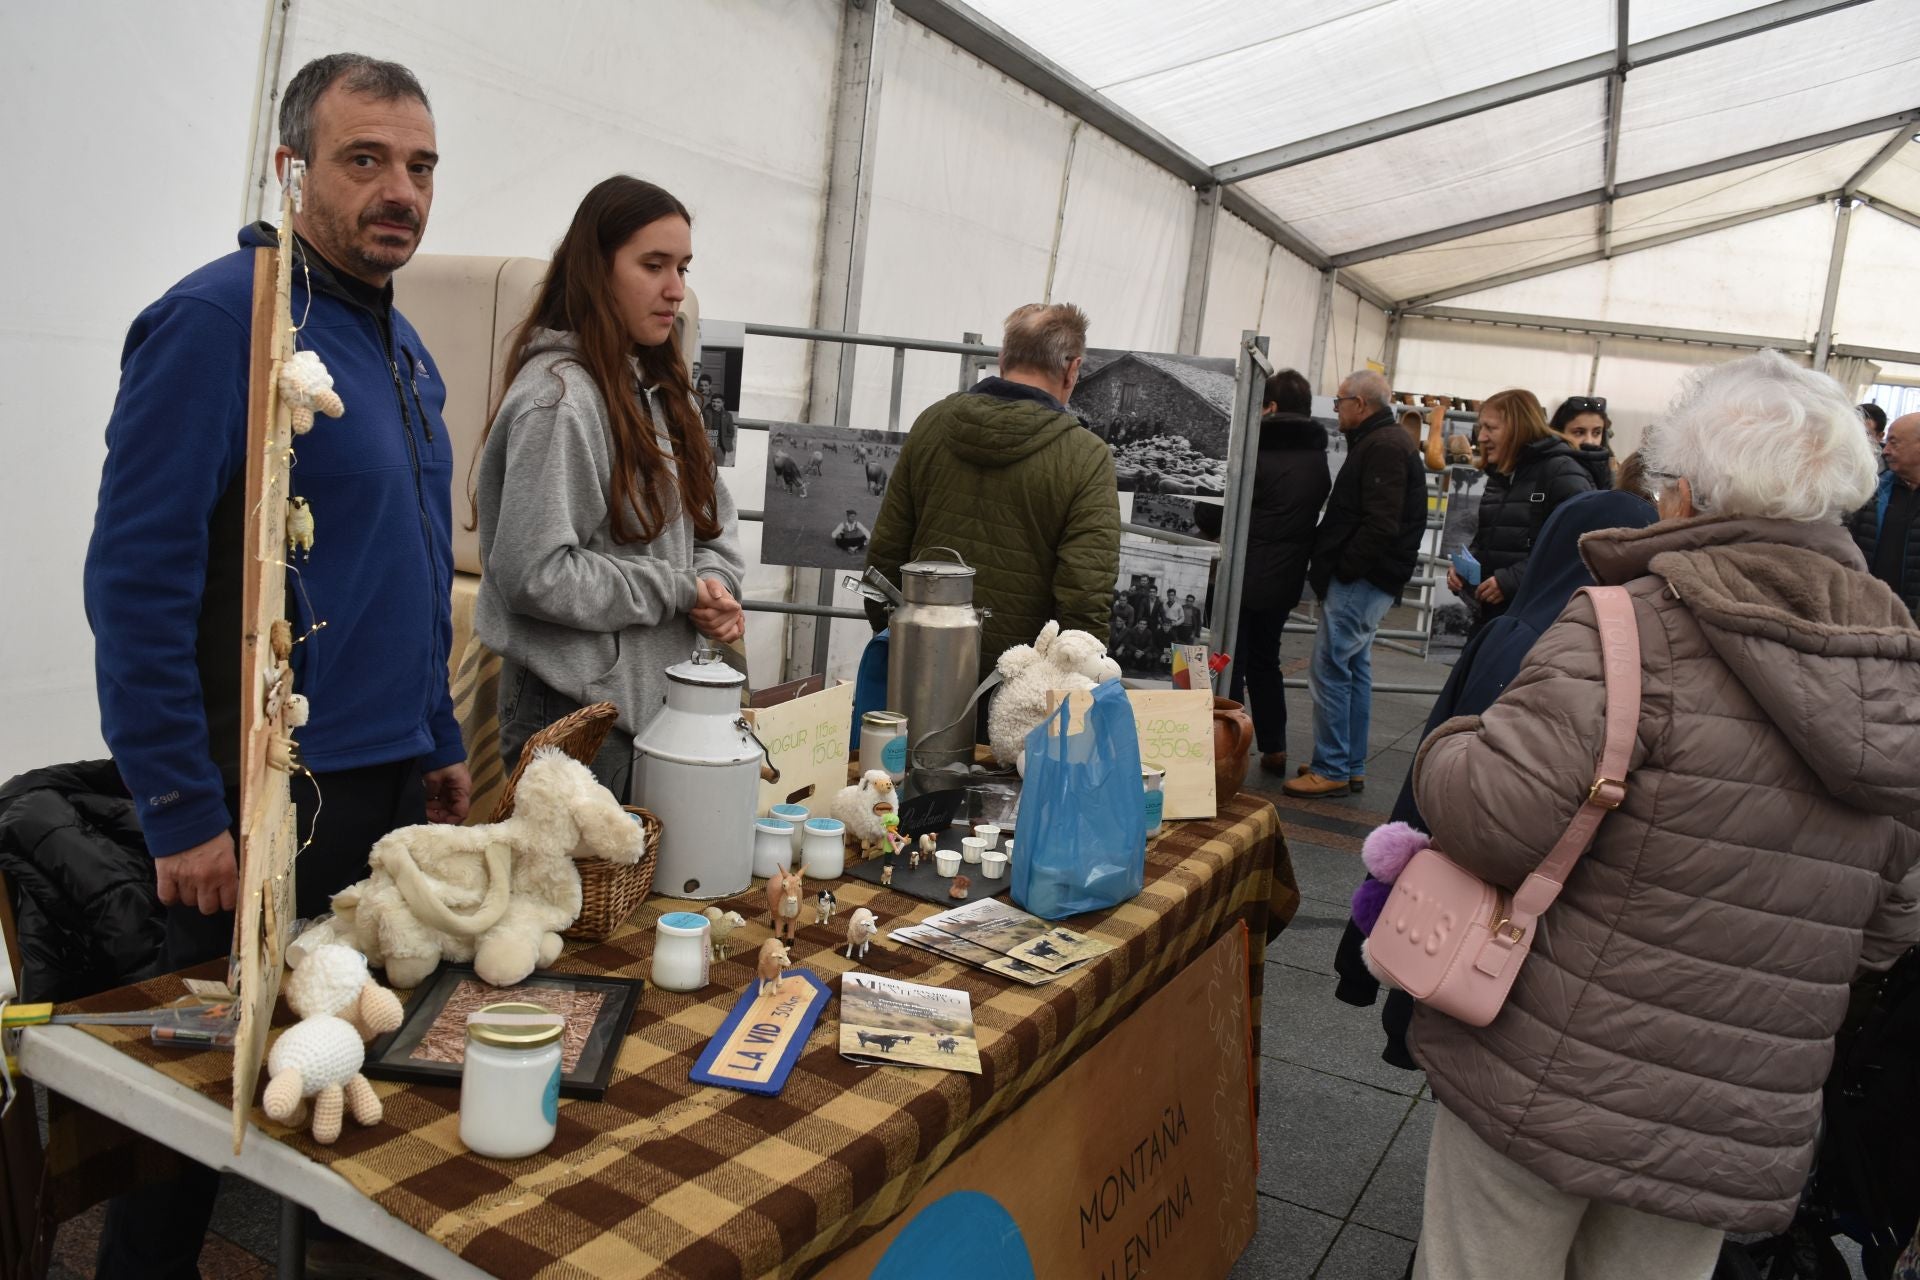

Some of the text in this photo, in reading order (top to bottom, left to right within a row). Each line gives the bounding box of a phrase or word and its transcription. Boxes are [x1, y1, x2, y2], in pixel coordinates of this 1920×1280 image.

[744, 1023, 781, 1043] VID
[727, 1051, 767, 1071] LA
[1080, 1101, 1188, 1248] MONTAÑA
